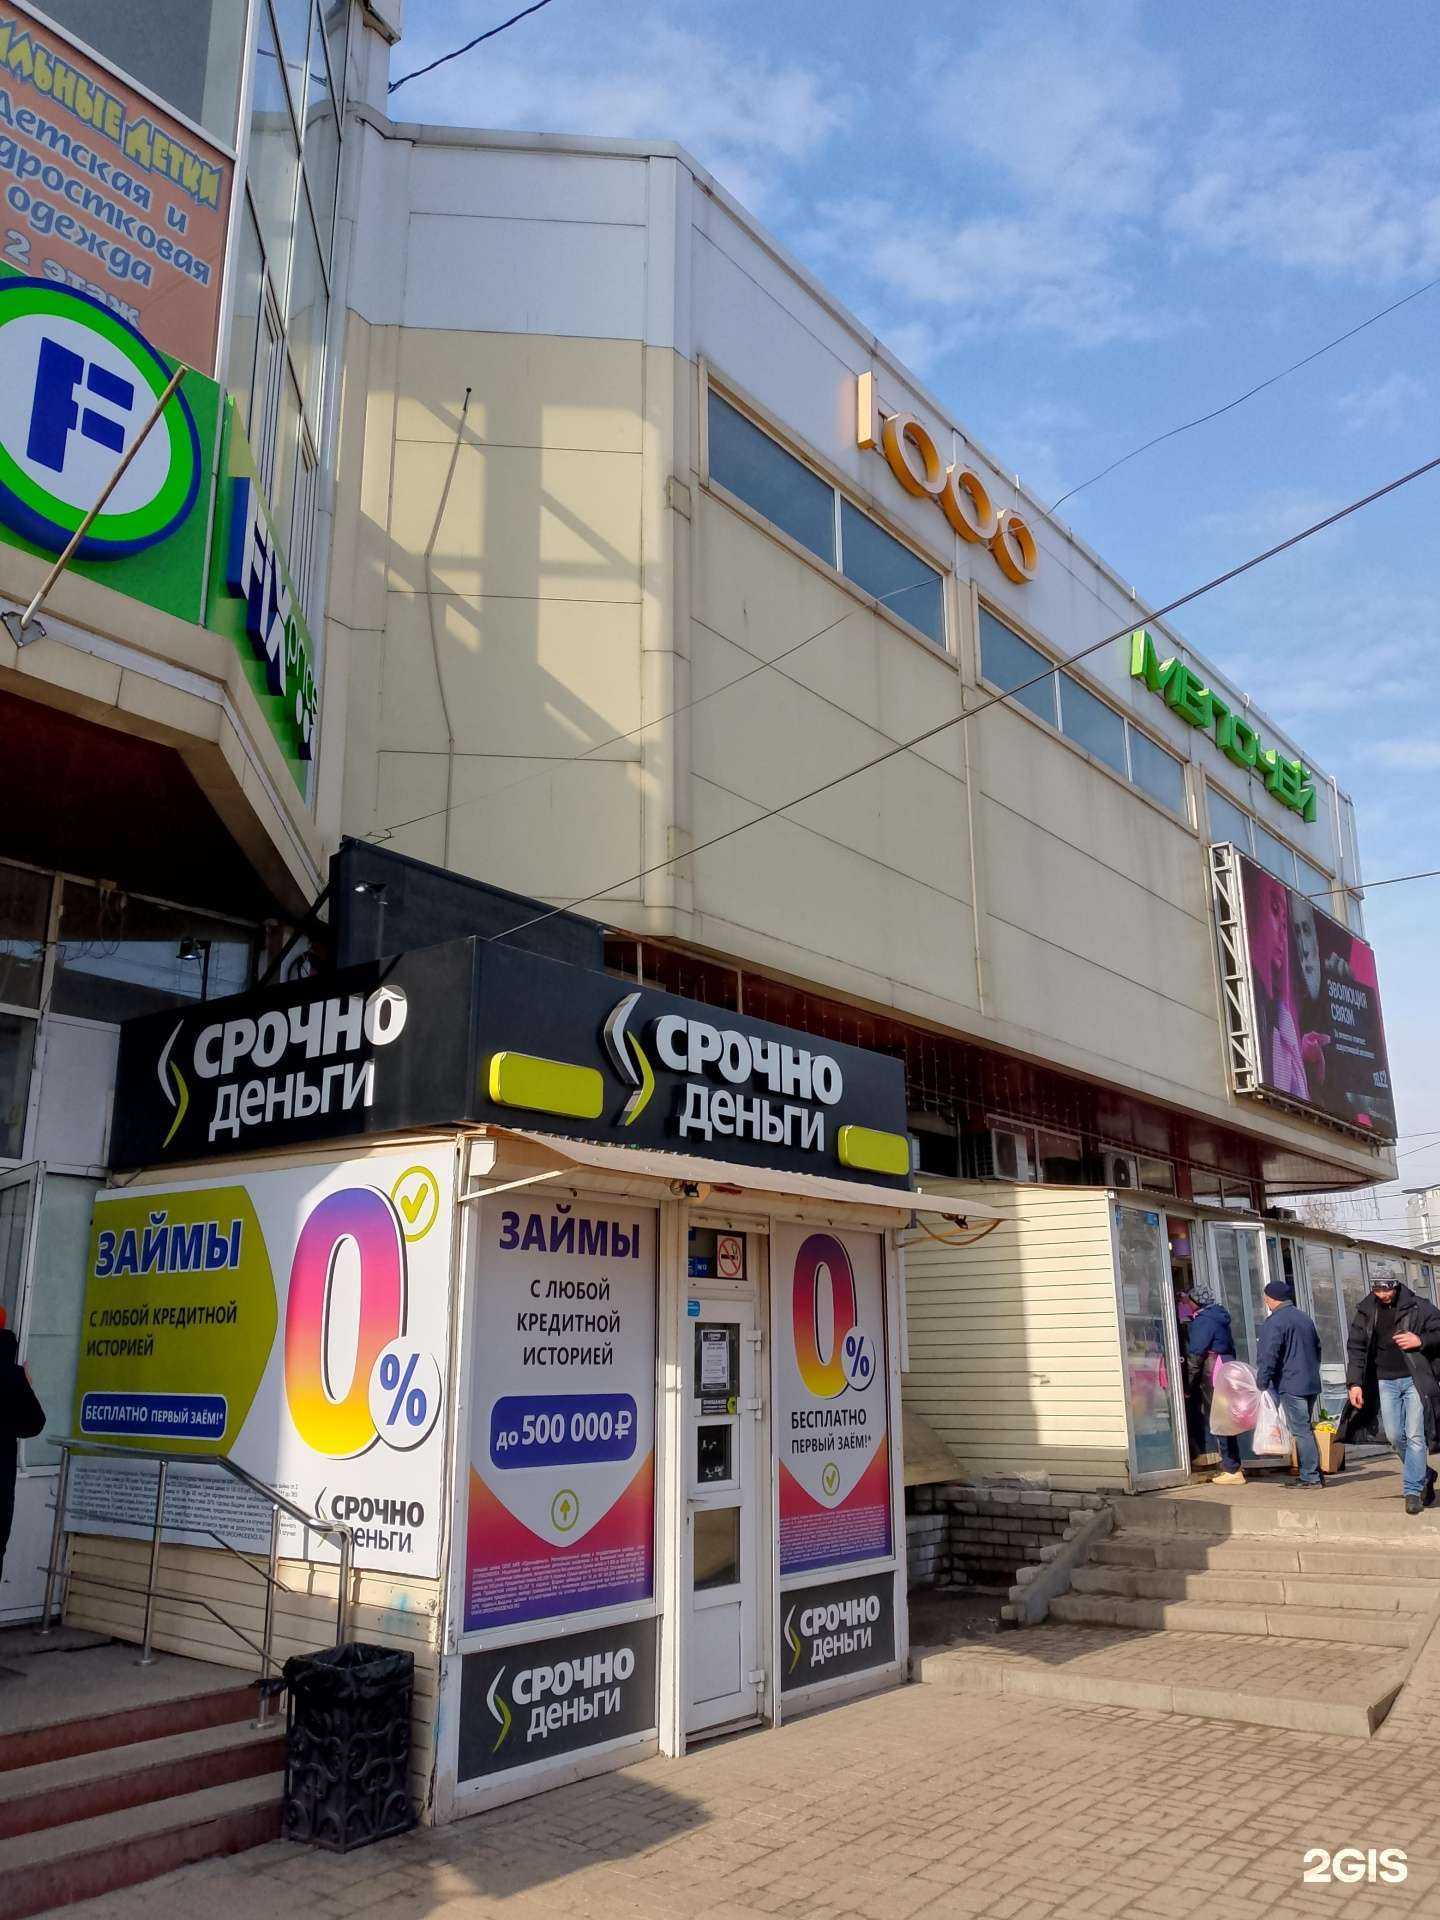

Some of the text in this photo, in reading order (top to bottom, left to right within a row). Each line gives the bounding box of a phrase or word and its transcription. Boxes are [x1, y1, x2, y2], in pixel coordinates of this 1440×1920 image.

[122, 117, 224, 212] ДЕТКИ
[7, 185, 153, 287] одежда
[167, 205, 188, 234] и
[5, 230, 32, 267] 2
[857, 371, 1038, 585] 1000
[193, 984, 408, 1079] СРОЧНО
[655, 1014, 843, 1106] СРОЧНО
[95, 1211, 242, 1277] ЗАЙМЫ
[499, 1203, 640, 1259] ЗАЙМЫ
[530, 1277, 610, 1301] С ЛЮБОЙ
[90, 1300, 238, 1328] С ЛЮБОЙ КРЕДИТНОЙ
[516, 1310, 621, 1337] КРЕДИТНОЙ
[87, 1334, 154, 1357] ИСТОРИЕЙ
[523, 1341, 613, 1366] ИСТОРИЕЙ
[85, 1404, 148, 1422] БЕСПЛАТНО
[151, 1408, 188, 1424] ПЕРВЫЙ
[791, 1408, 867, 1430] БЕСПЛАТНО
[496, 1430, 519, 1451] до
[521, 1413, 565, 1446] 500
[791, 1432, 835, 1454] ПЕРВЫЙ
[330, 1494, 424, 1528] СРОЧНО
[353, 1527, 413, 1554] еньги
[800, 1595, 880, 1637] СРОЧНО
[511, 1648, 635, 1706] СРОЧНО
